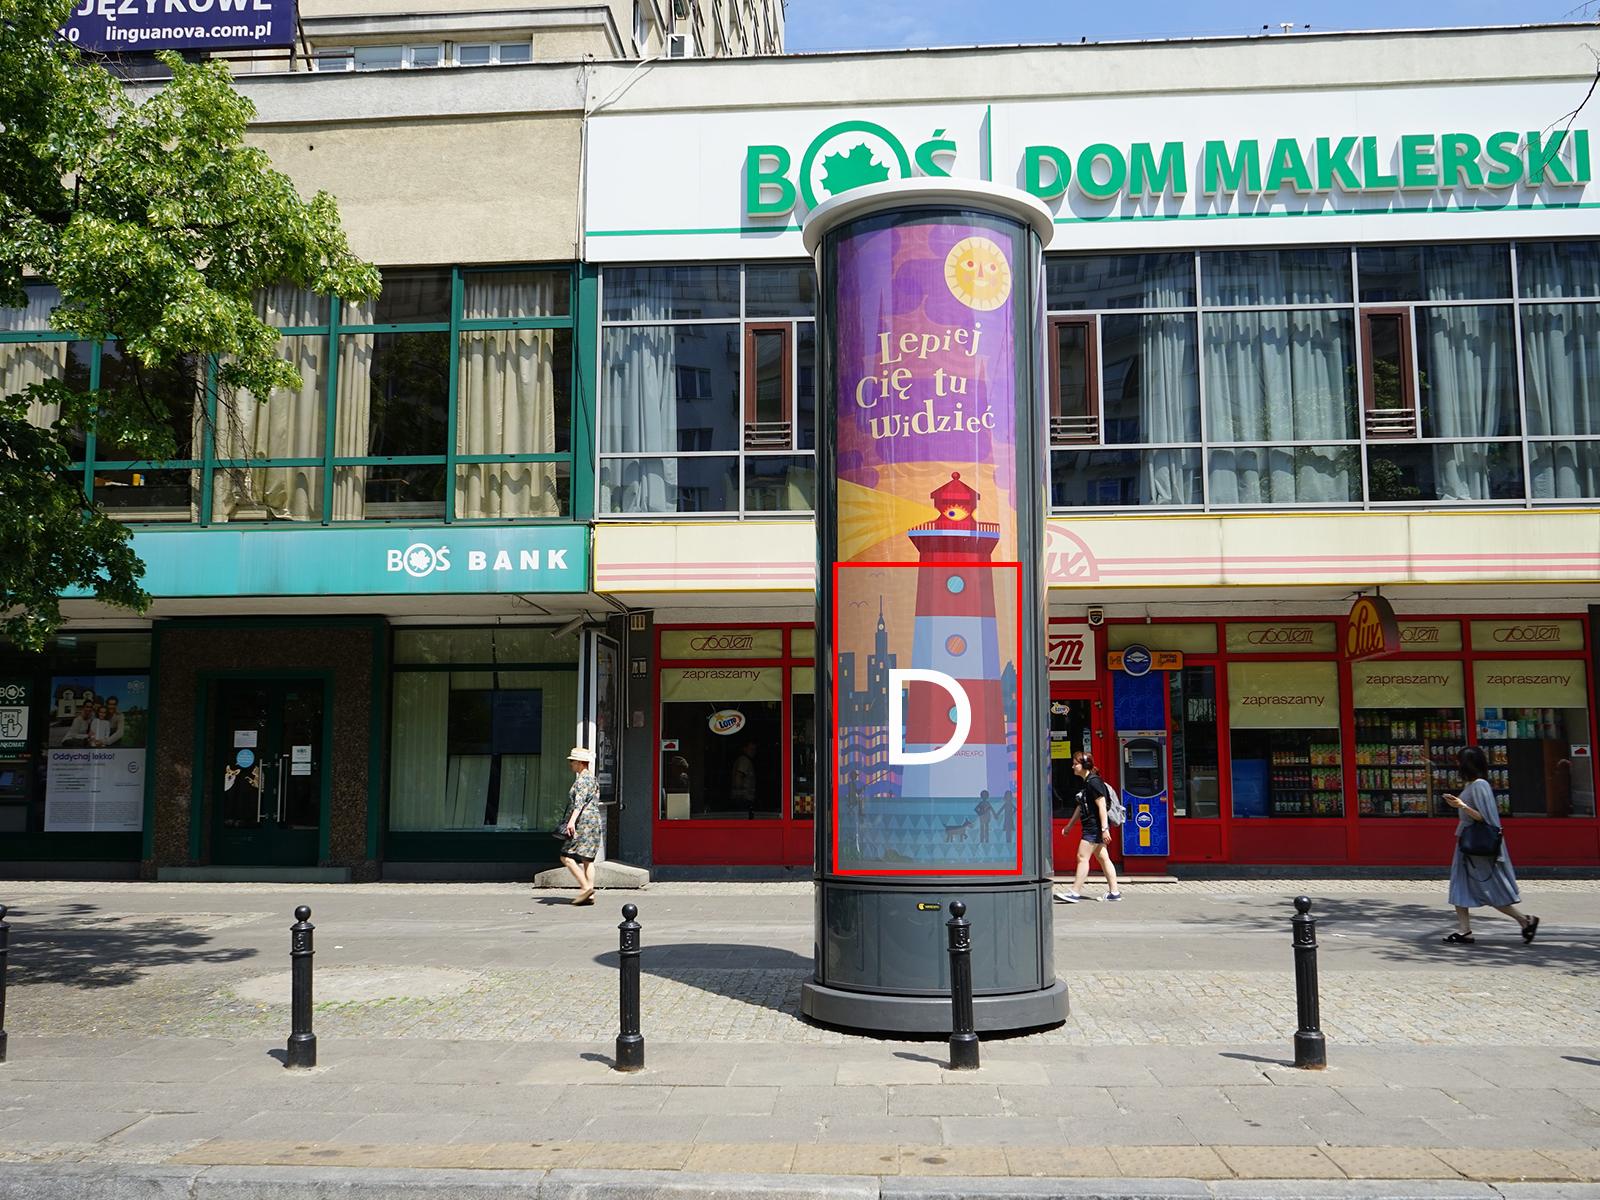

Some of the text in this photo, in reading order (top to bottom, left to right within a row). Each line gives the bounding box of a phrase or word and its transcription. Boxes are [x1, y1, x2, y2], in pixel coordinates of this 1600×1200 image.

[105, 21, 272, 43] linguanova.com.pl
[1025, 140, 1188, 200] DOM
[1203, 129, 1590, 197] MAKLERSKI
[877, 322, 982, 365] Lepiej
[855, 367, 967, 408] Cię tu
[869, 399, 996, 439] widzieć
[387, 543, 569, 578] BOŚ BANK
[682, 669, 761, 682] zapraszamy
[1366, 675, 1450, 686] zapraszamy
[1487, 675, 1572, 686] zapraszamy
[1242, 695, 1325, 707] zapraszamy
